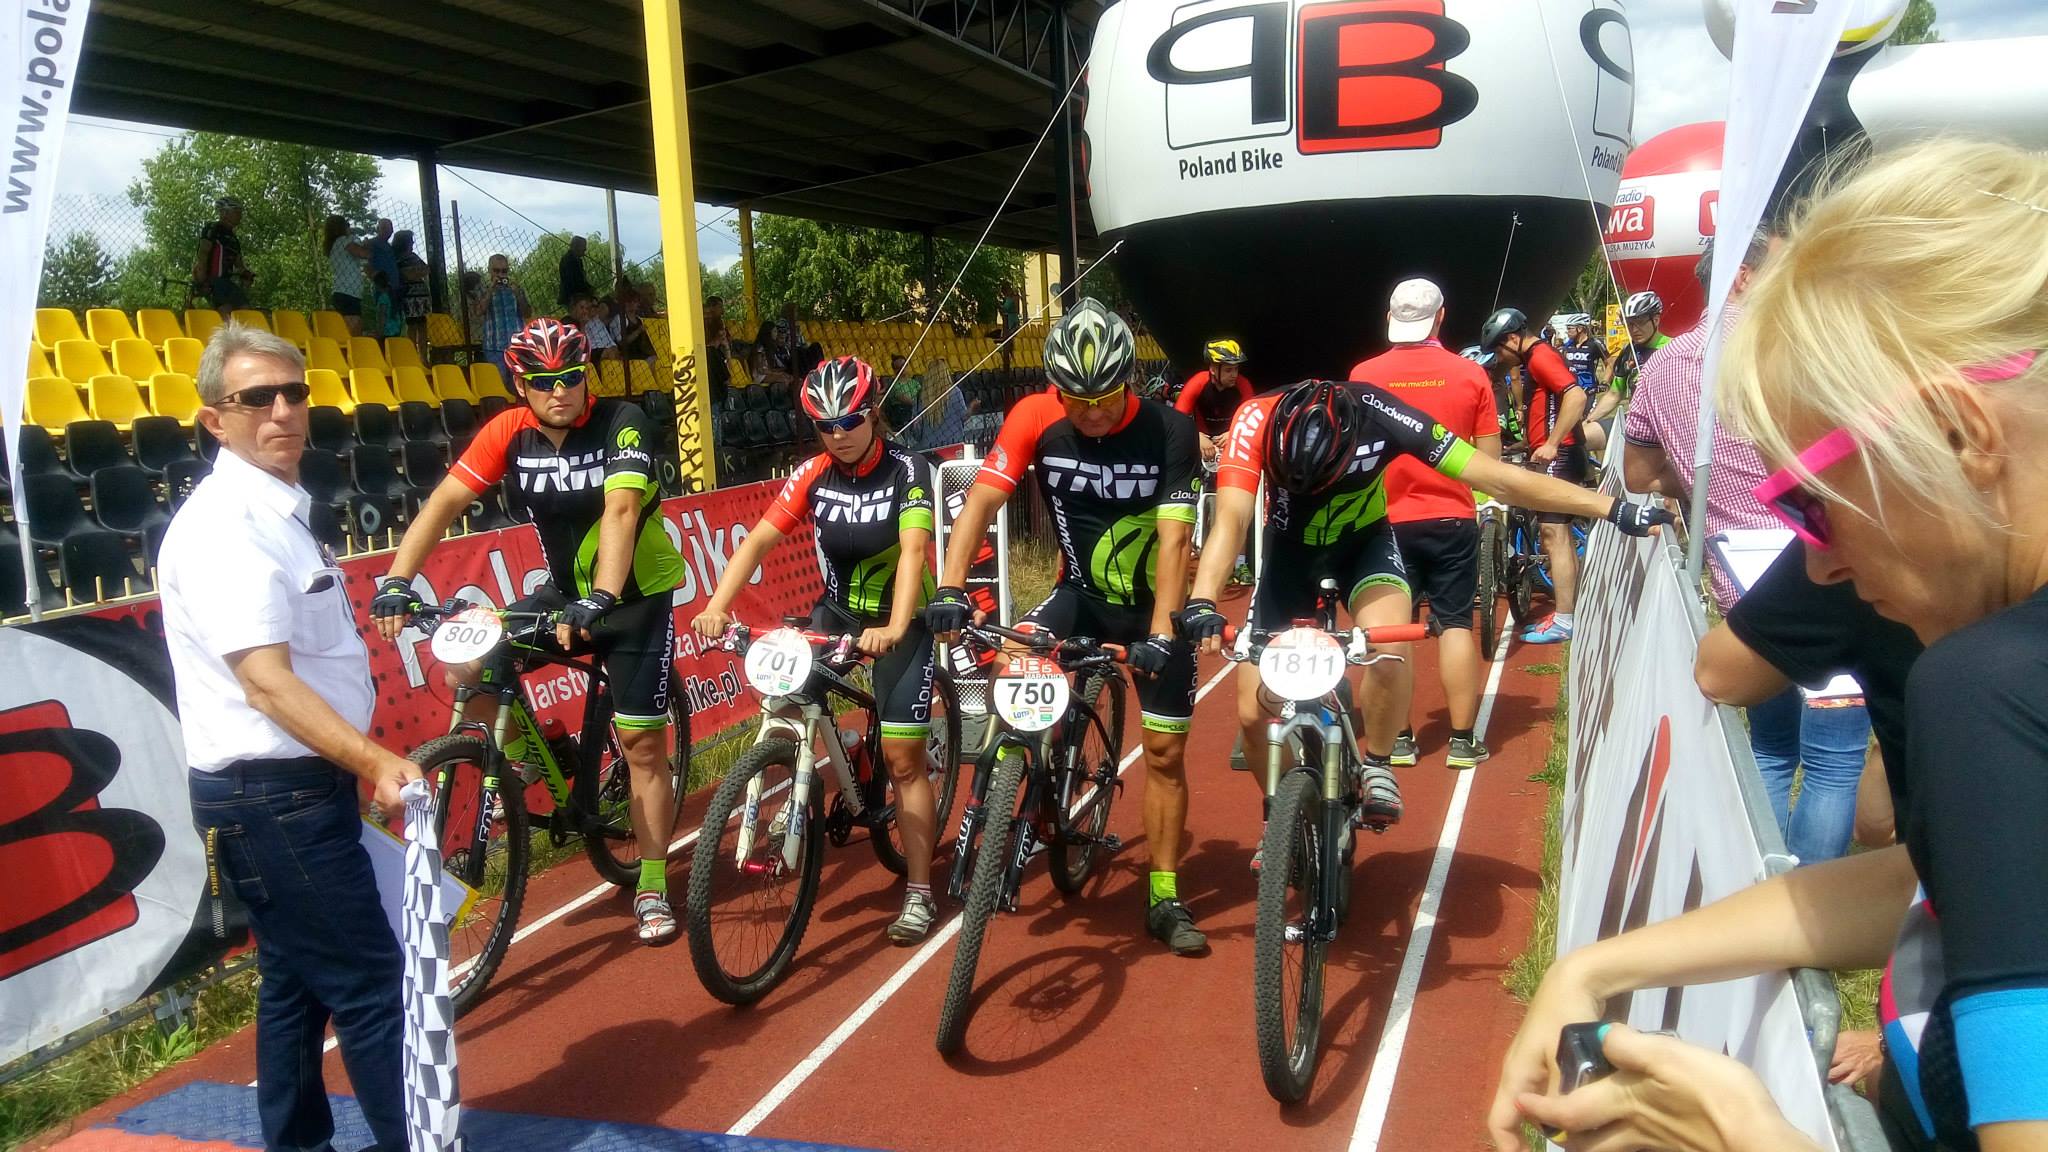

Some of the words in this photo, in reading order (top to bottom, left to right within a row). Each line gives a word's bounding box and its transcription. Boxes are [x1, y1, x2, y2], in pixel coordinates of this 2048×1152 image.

[1179, 151, 1237, 180] Poland
[1241, 147, 1284, 172] Bike
[1616, 189, 1642, 204] radio
[1608, 206, 1645, 235] wa
[1228, 402, 1265, 462] TRW
[1362, 393, 1424, 433] cloudware
[516, 448, 605, 493] TRW
[1041, 456, 1160, 500] TRW
[814, 486, 895, 524] TRW
[1052, 495, 1088, 588] loudware
[445, 626, 488, 645] 800
[654, 611, 675, 709] cloudware
[758, 647, 798, 676] 701
[1269, 652, 1334, 676] 1811
[524, 667, 590, 713] larstw
[911, 640, 936, 721] cloudw
[1007, 682, 1055, 705] 750
